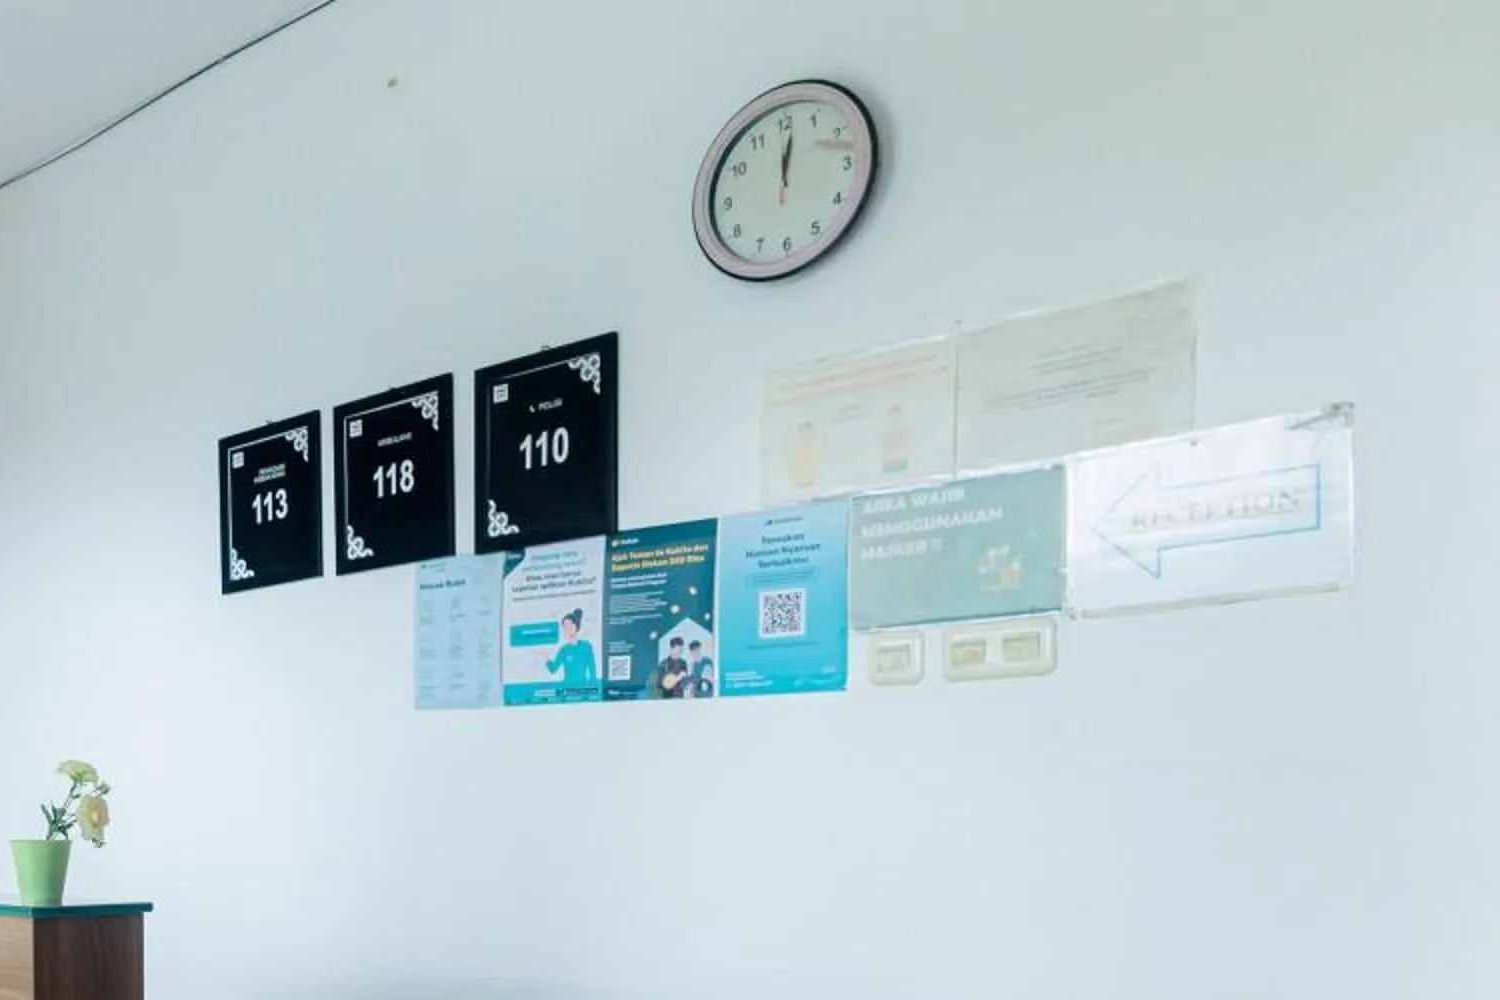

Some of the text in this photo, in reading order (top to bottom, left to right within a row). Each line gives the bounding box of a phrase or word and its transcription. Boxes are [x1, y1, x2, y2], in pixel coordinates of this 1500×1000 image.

[778, 115, 793, 132] 12
[809, 114, 818, 127] 1
[750, 133, 766, 150] 11
[732, 161, 747, 176] 10
[842, 155, 852, 171] 3
[723, 197, 733, 211] 9
[832, 192, 842, 204] 4
[733, 224, 742, 238] 8
[811, 221, 821, 235] 5
[755, 237, 765, 252] 7
[782, 236, 792, 252] 6
[519, 426, 570, 471] 110
[372, 459, 415, 498] 118
[251, 488, 289, 525] 113
[862, 497, 908, 514] AREA
